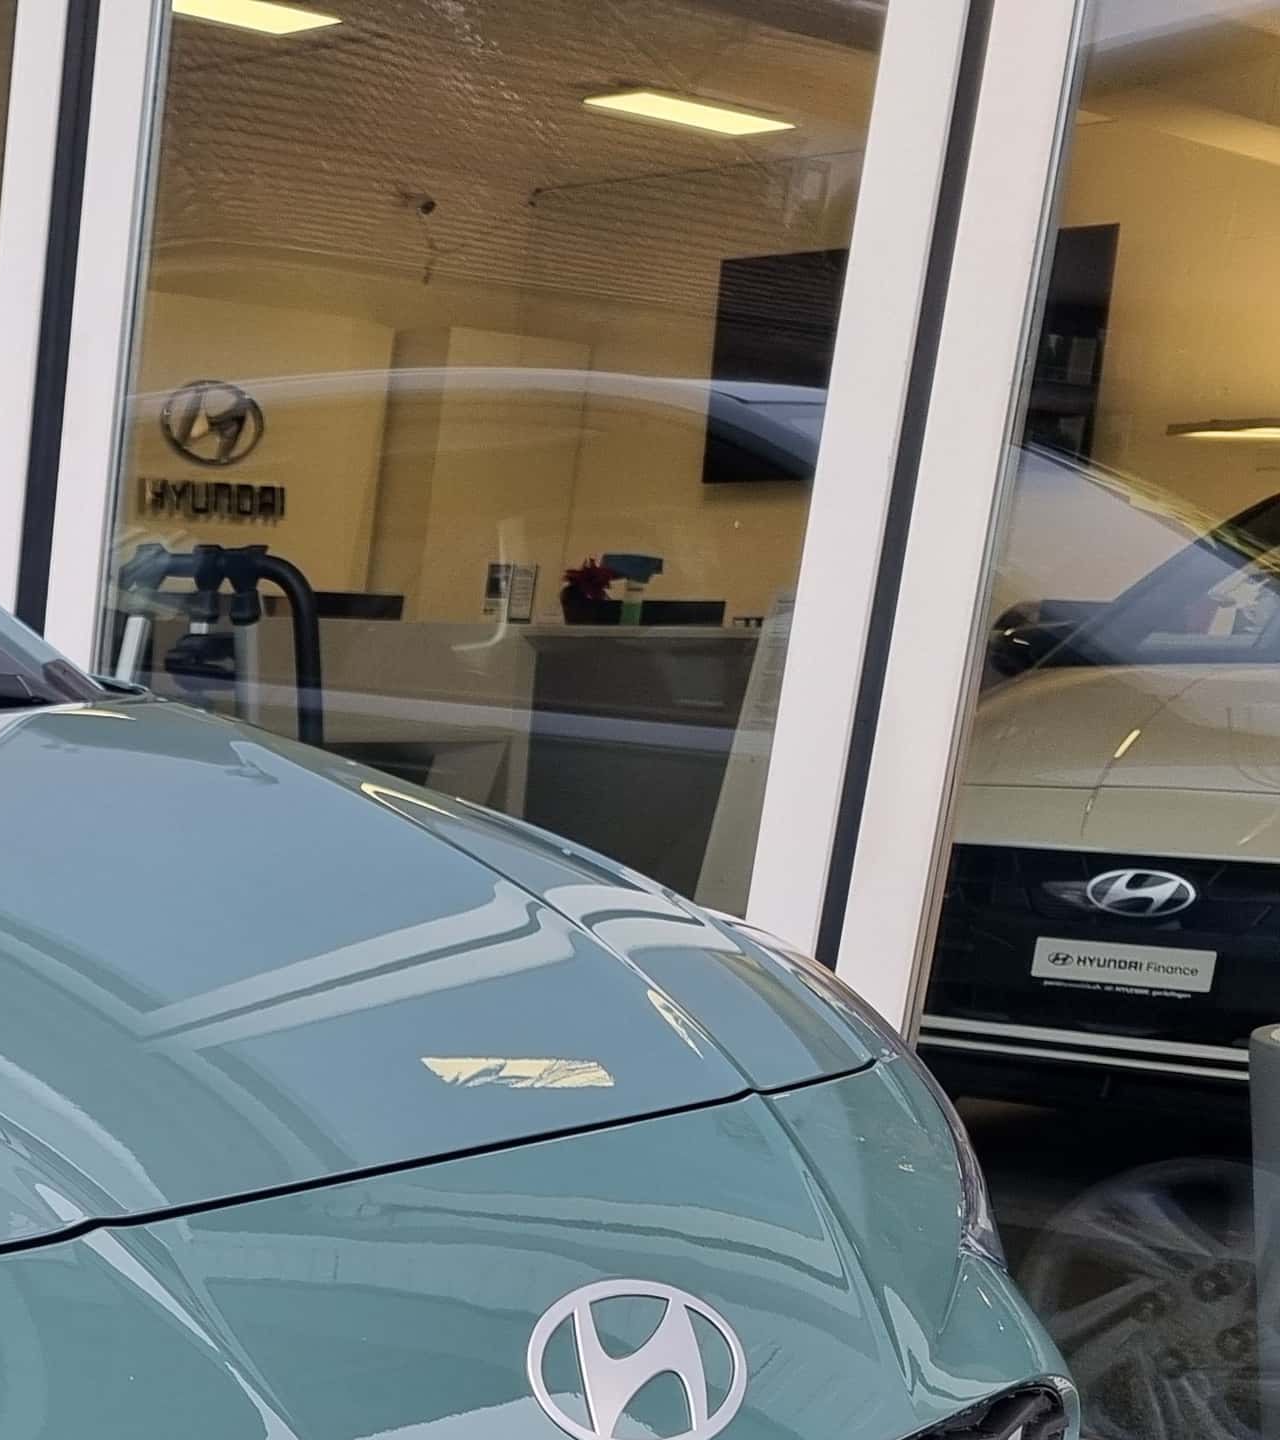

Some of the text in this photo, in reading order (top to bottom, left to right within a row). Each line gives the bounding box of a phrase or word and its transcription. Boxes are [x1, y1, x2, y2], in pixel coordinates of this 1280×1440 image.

[138, 477, 286, 520] HYUNDAI
[1076, 955, 1200, 978] HYUNDAI Finance
